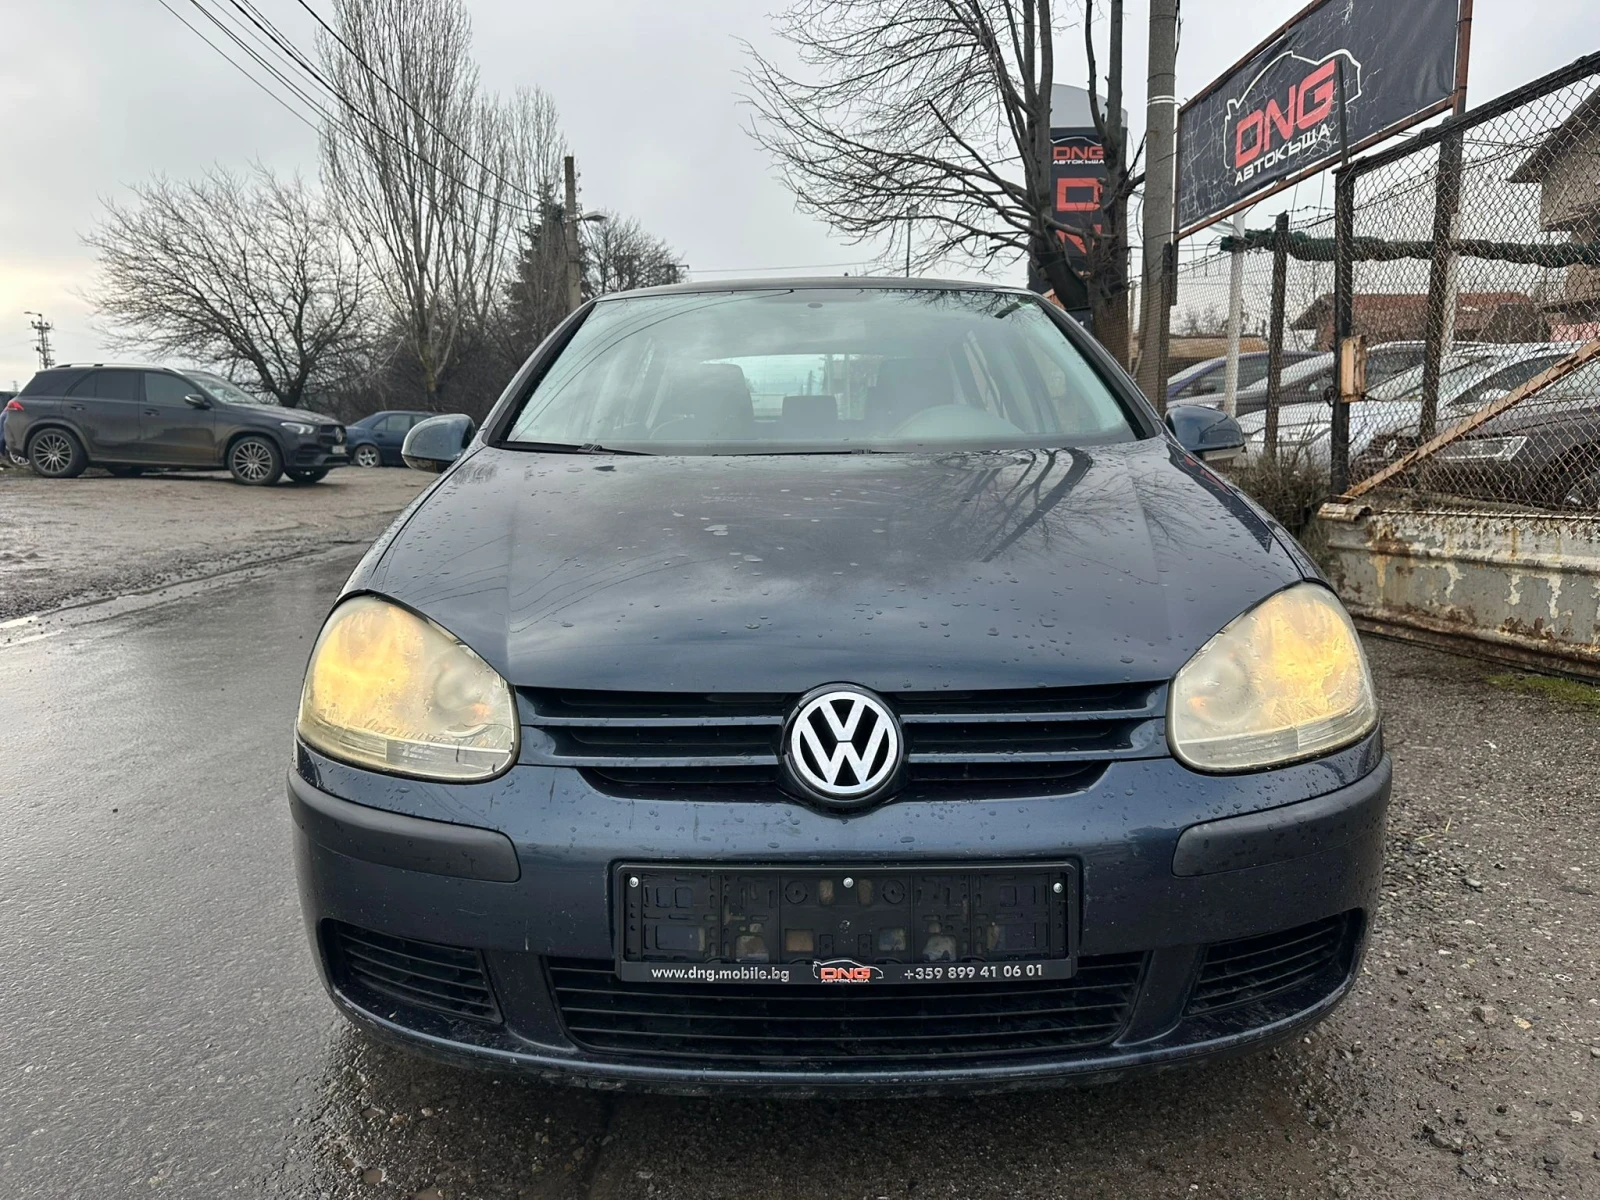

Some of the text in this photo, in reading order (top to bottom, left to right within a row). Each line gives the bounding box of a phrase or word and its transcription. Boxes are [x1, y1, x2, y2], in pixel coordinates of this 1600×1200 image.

[1235, 59, 1335, 169] DNG
[1053, 146, 1104, 160] DNG
[651, 966, 790, 982] www.dng.mobile.bg
[820, 967, 871, 979] DNG
[904, 964, 1042, 980] +359 899 41 06 01
